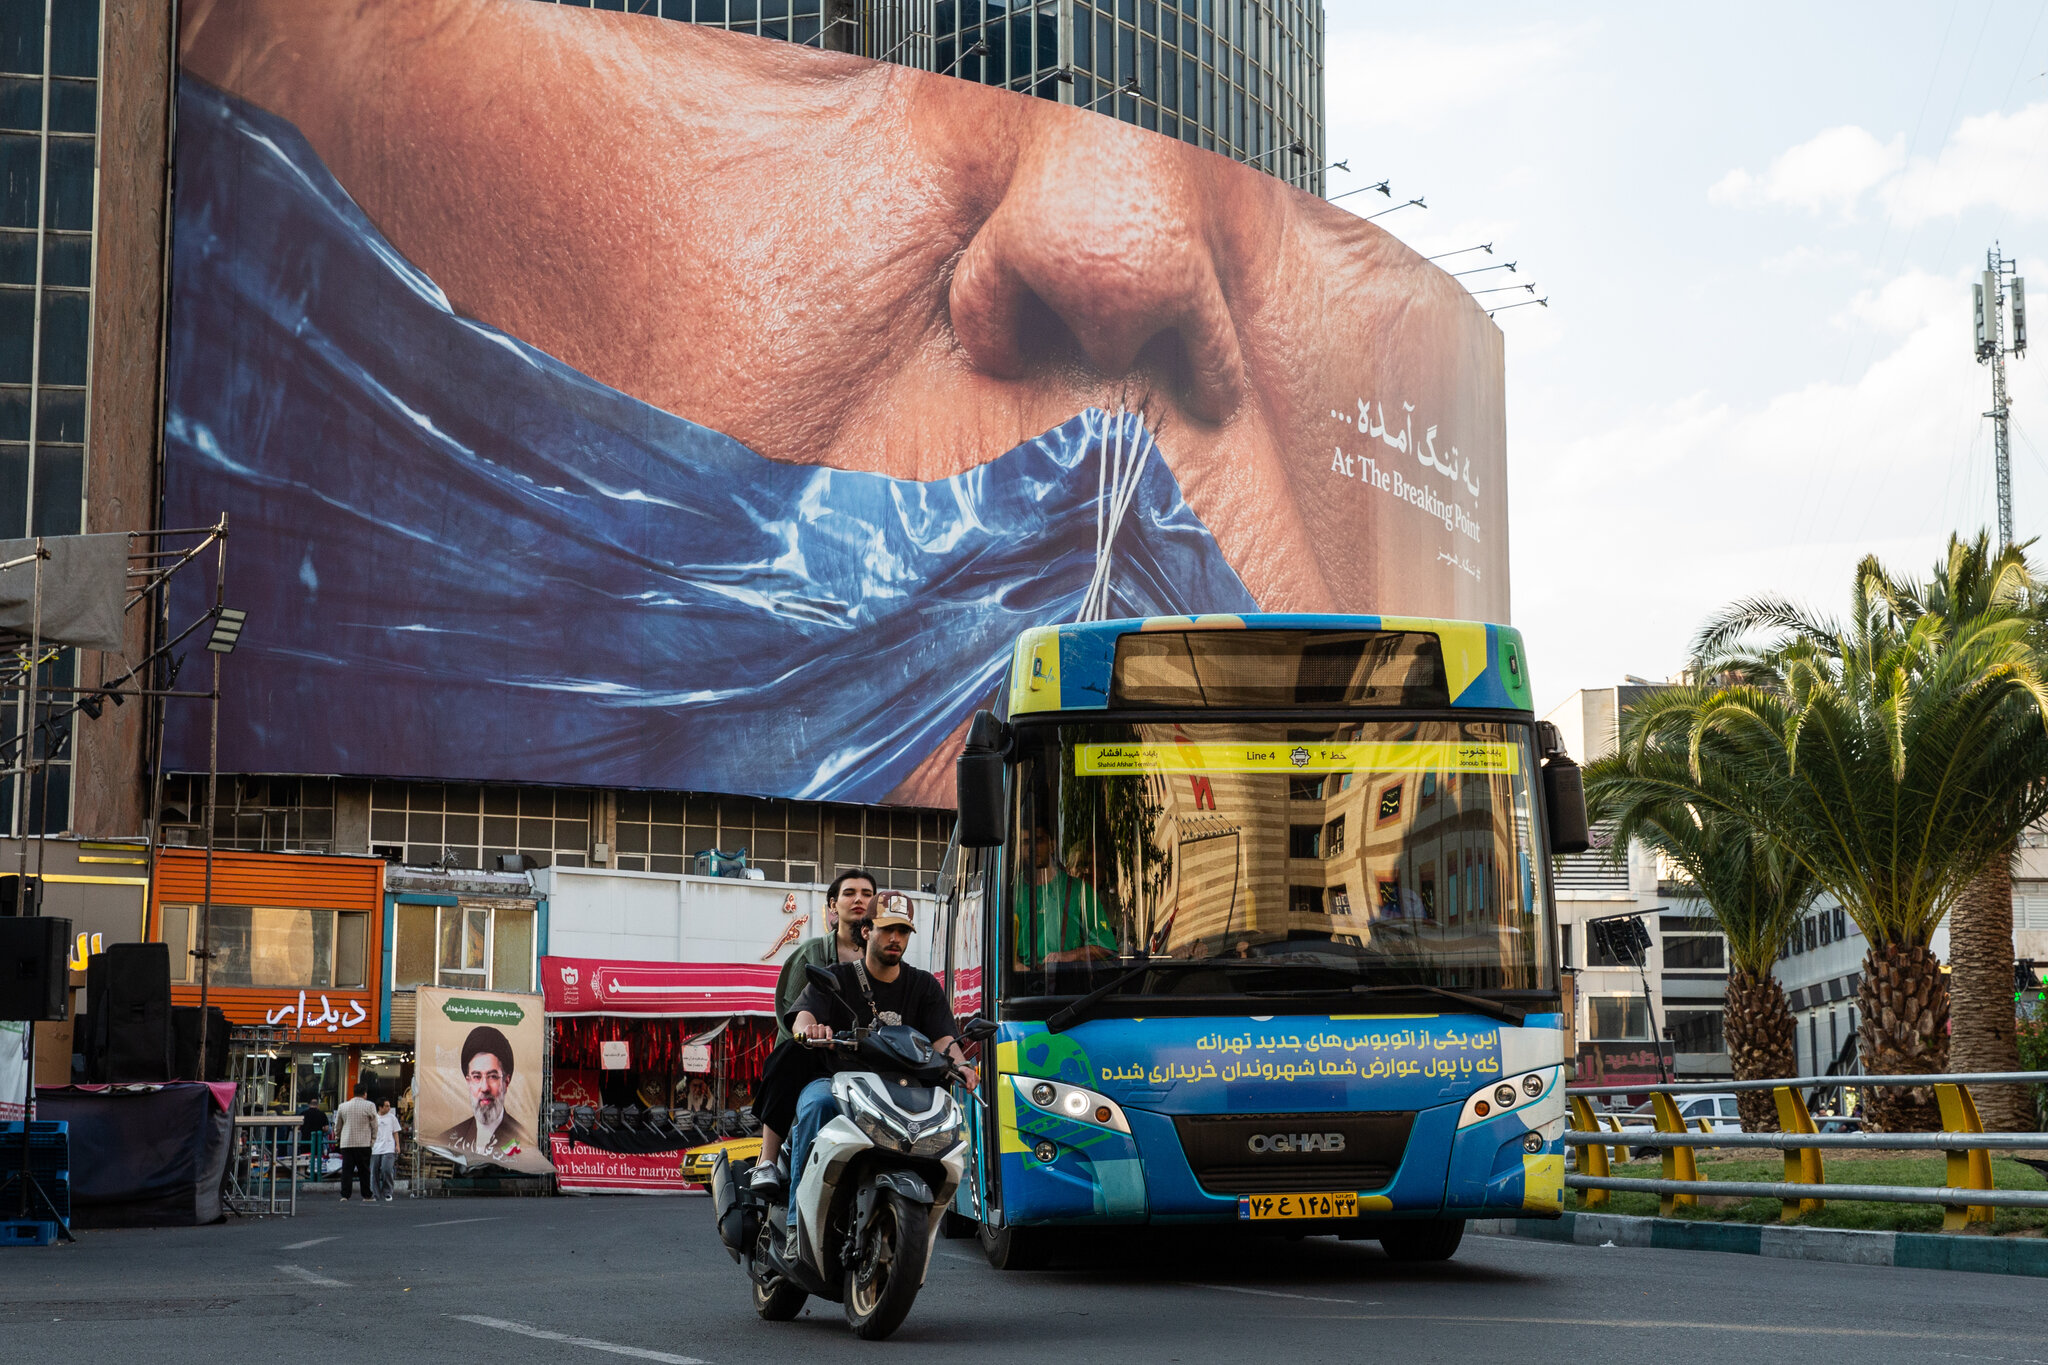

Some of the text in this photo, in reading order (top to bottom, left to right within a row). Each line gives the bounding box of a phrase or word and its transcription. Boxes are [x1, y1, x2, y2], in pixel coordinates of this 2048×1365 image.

[1417, 424, 1458, 481] تنگ
[1462, 456, 1480, 509] به
[1330, 446, 1481, 543] At The Breaking Point
[1097, 747, 1122, 759] افشار
[1246, 751, 1276, 761] Line 4
[1320, 750, 1347, 760] خط ۴
[1458, 747, 1486, 758] جنوب
[1196, 1033, 1252, 1055] تهرانه
[1256, 1036, 1302, 1054] جدید
[1417, 1030, 1430, 1050] از
[1433, 1029, 1468, 1050] یکی
[1471, 1030, 1499, 1050] این
[1102, 1056, 1499, 1084] که با پول عوارض شما شهروندان خریداری شده
[1247, 1133, 1346, 1153] OGHAB
[571, 1161, 606, 1175] behalf
[607, 1162, 618, 1175] of
[619, 1163, 637, 1177] the
[639, 1166, 681, 1180] martyrs
